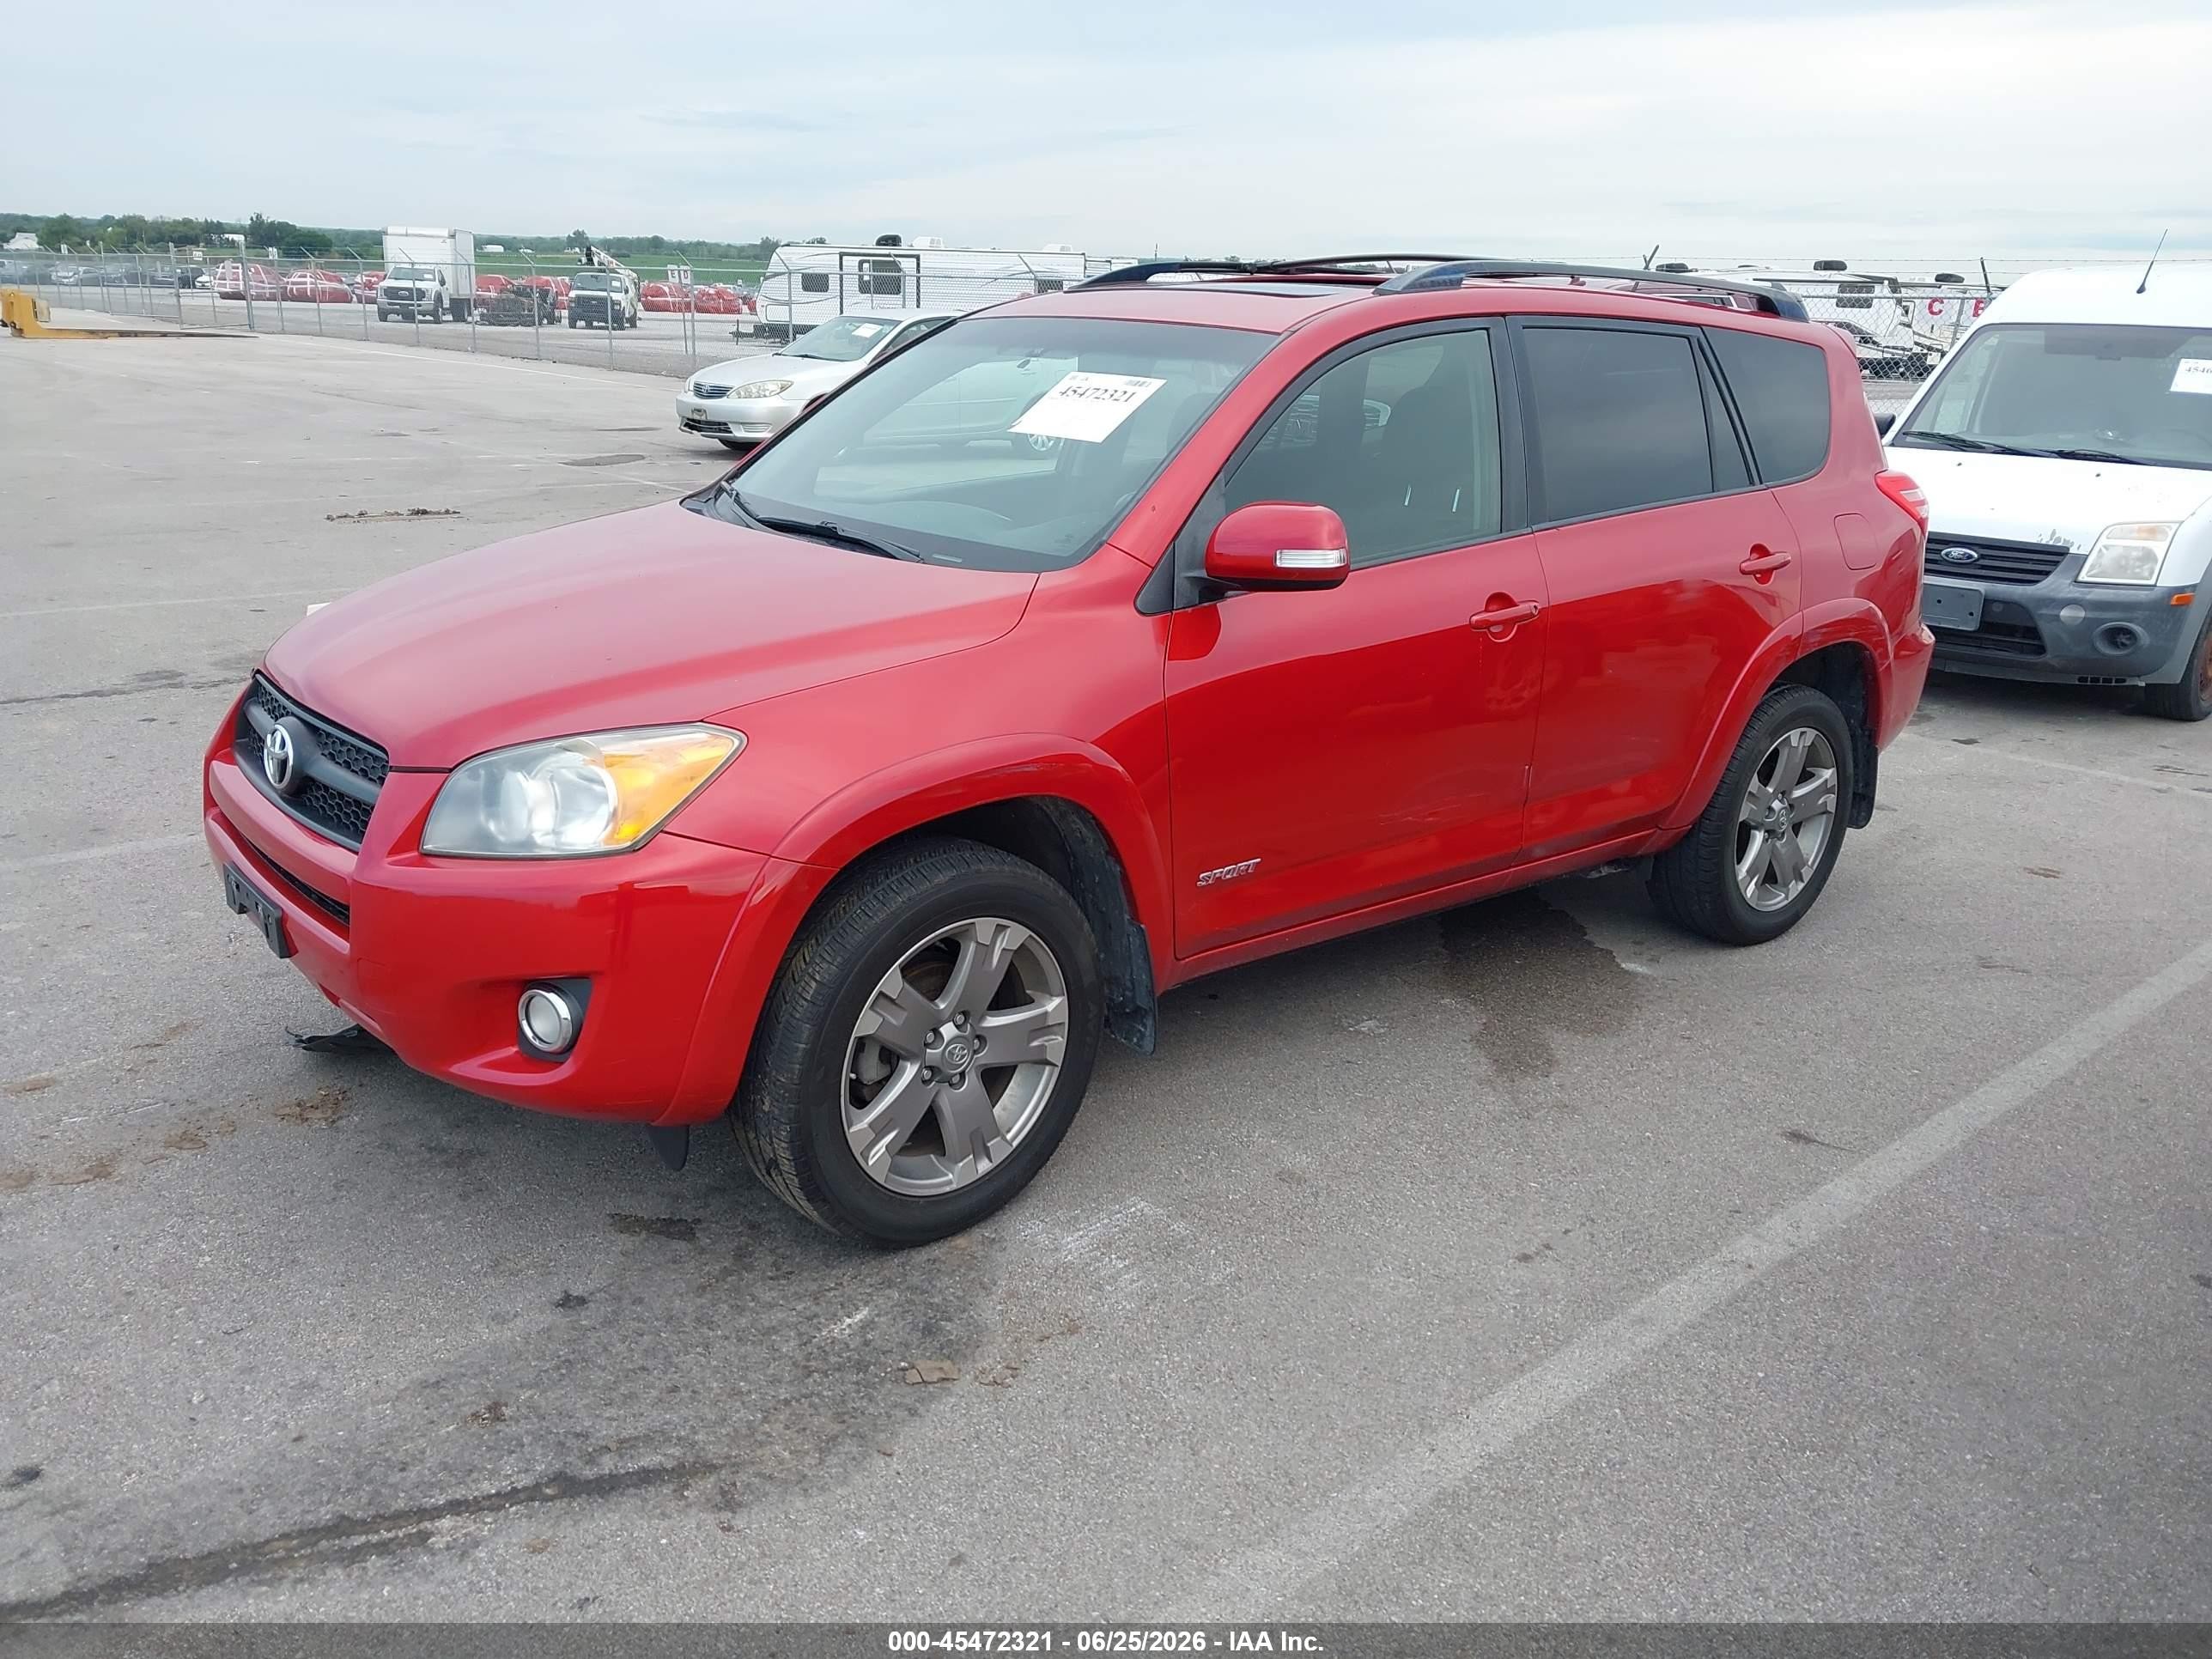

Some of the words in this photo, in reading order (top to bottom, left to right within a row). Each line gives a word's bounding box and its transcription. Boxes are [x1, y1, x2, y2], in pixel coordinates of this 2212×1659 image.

[1928, 297, 1945, 316] C
[1058, 385, 1138, 403] 45472321
[1197, 858, 1261, 887] SPORT
